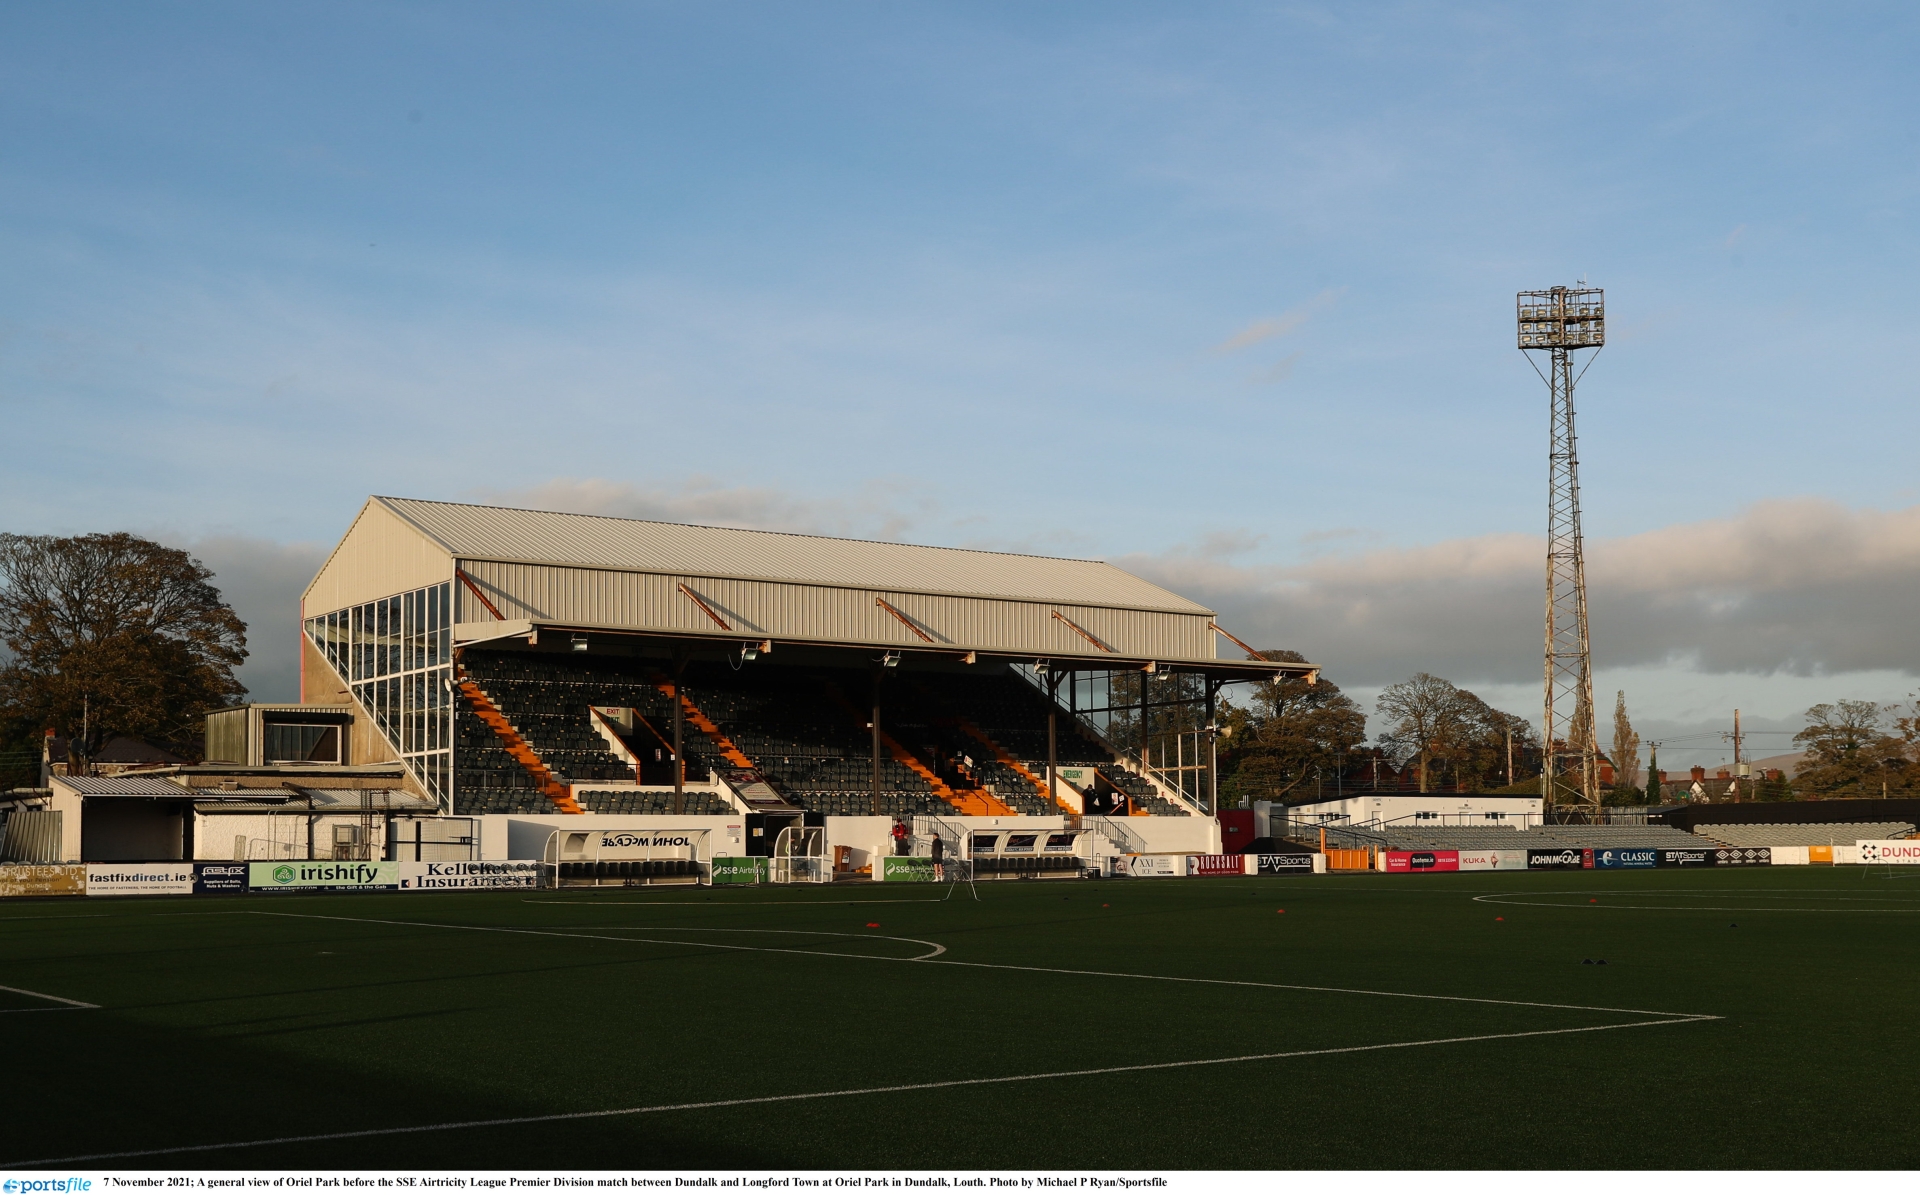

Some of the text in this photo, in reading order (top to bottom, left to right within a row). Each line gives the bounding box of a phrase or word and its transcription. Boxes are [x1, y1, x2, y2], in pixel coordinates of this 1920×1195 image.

[1063, 769, 1083, 779] EMERGENCY
[1411, 856, 1434, 864] Quoteme.ie
[1531, 855, 1551, 865] JOHN
[1620, 852, 1655, 862] CLASSIC
[1139, 858, 1154, 867] XXI
[1200, 855, 1239, 870] ROCKSALT
[6, 867, 78, 877] TRUSTEES LTD
[301, 864, 378, 883] irishify
[722, 866, 738, 874] sse
[896, 865, 910, 873] sse
[89, 872, 187, 883] fastfixdirect.ie
